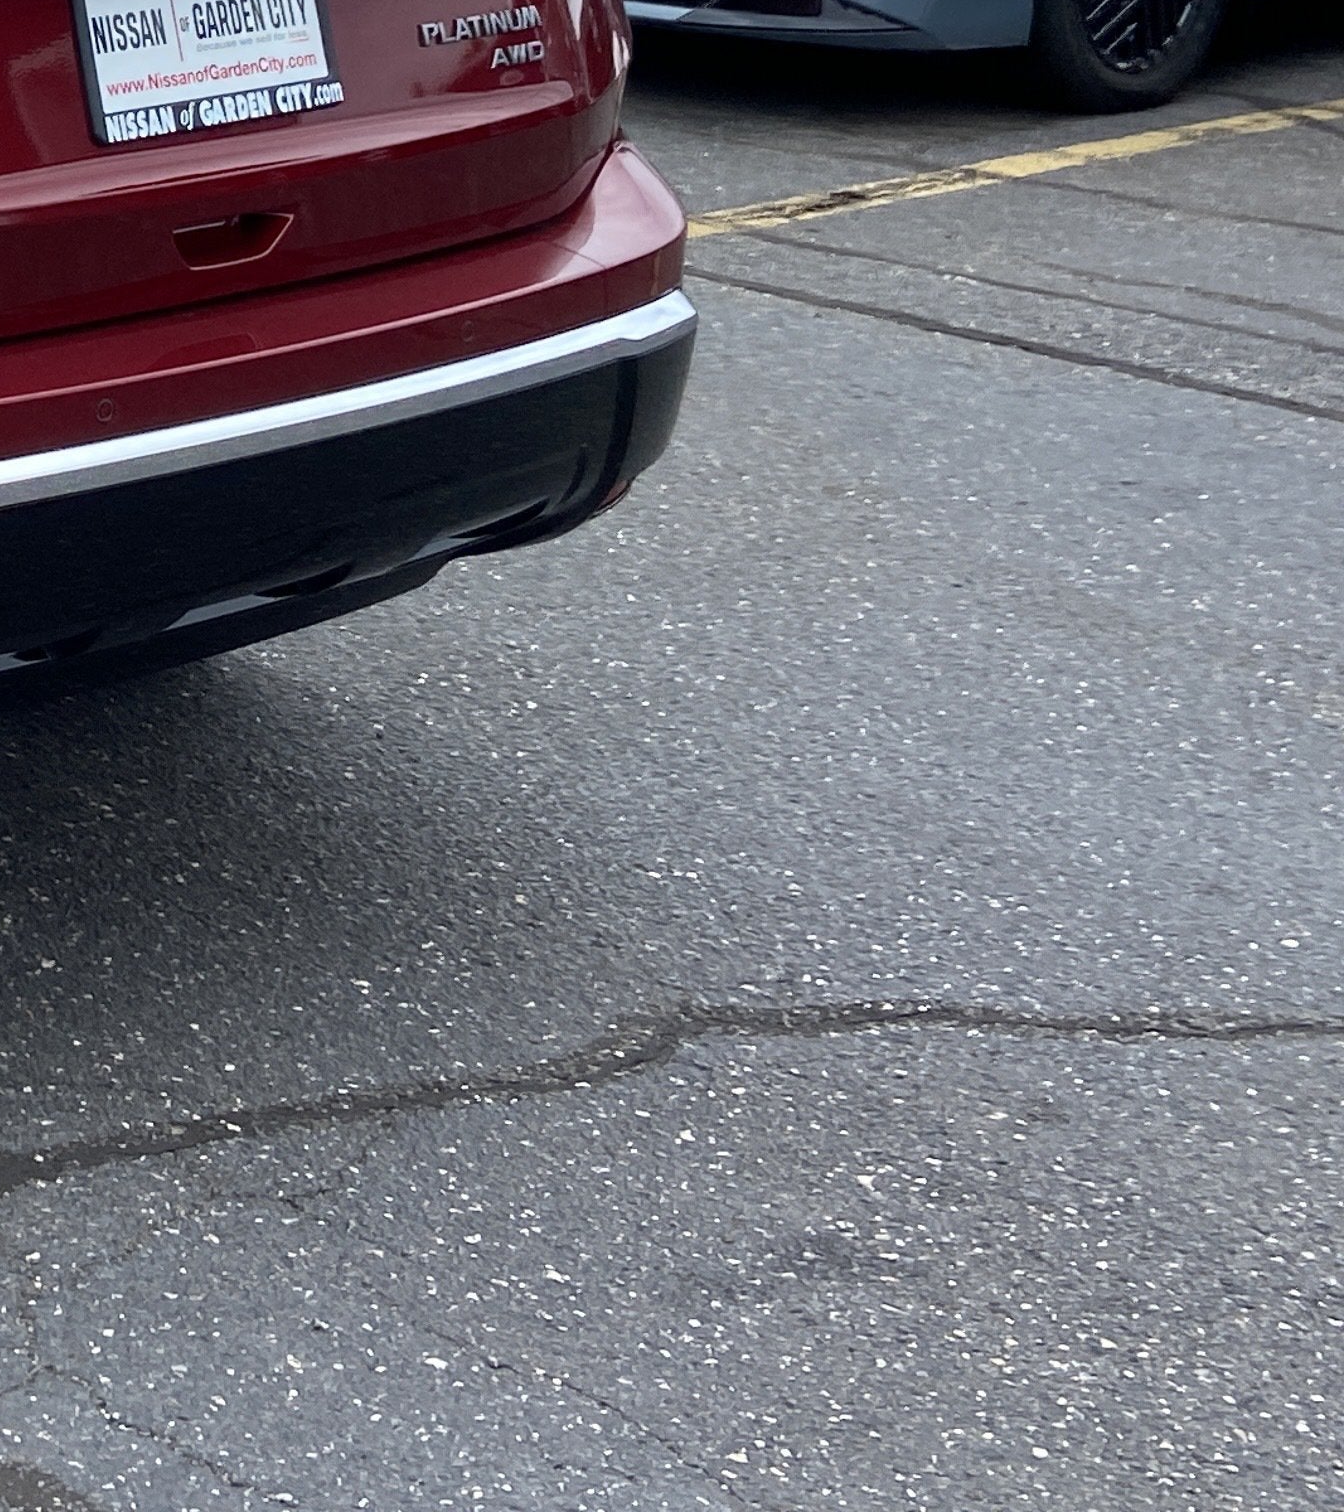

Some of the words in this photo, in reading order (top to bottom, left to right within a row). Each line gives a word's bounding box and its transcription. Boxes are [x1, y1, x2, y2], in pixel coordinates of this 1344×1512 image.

[91, 8, 168, 54] NISSAN
[419, 4, 543, 47] PLATINUM
[106, 52, 317, 96] www.NissanofGardenCity.com
[491, 40, 545, 69] AWD
[104, 105, 177, 144] NISSAN
[179, 102, 196, 131] of
[198, 90, 273, 126] GARDEN
[275, 81, 345, 112] CITY.com
